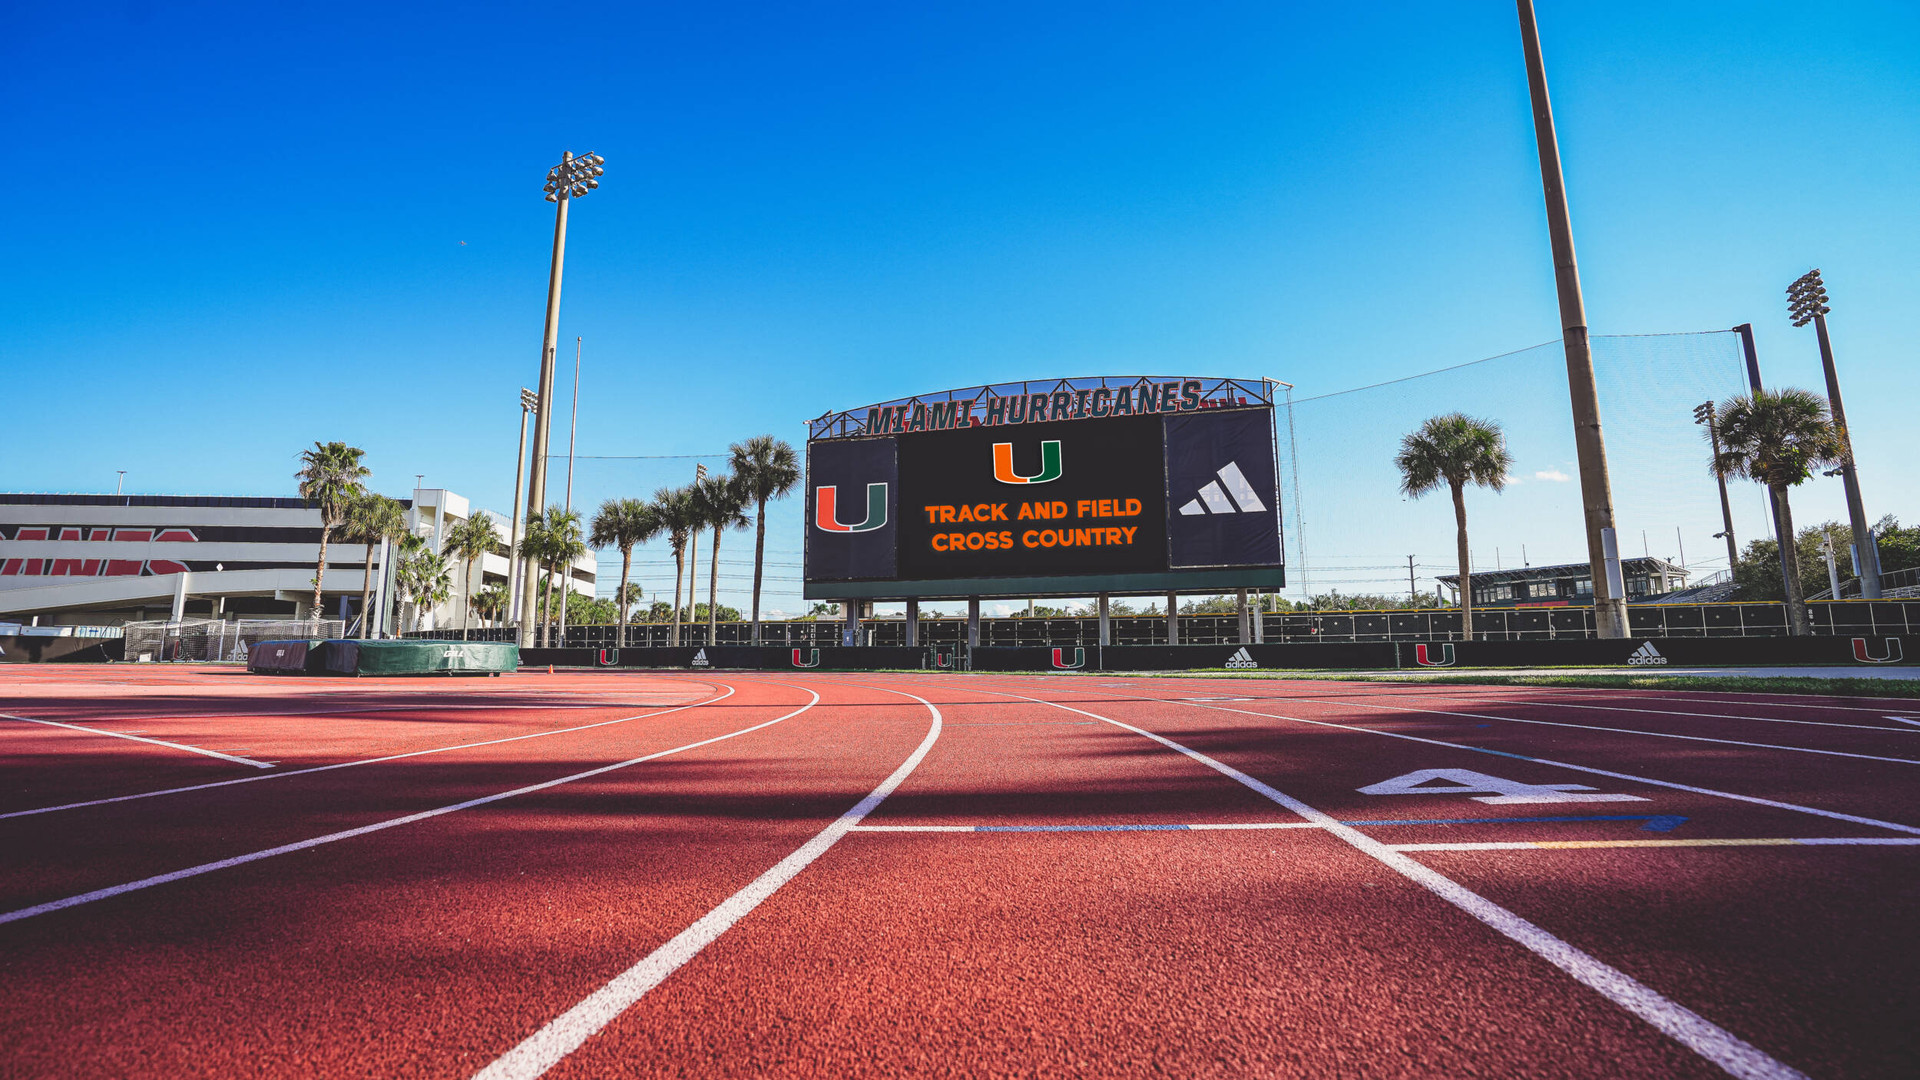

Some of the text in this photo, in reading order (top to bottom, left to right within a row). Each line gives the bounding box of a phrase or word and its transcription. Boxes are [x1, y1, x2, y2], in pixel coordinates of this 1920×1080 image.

[865, 380, 1203, 436] MIAMI HURRICANES
[992, 439, 1063, 485] U
[816, 482, 888, 533] U
[925, 498, 1142, 524] TRACK AND FIELD
[931, 526, 1138, 552] CROSS COUNTRY
[600, 648, 619, 666] U
[791, 648, 820, 668] U
[937, 653, 952, 667] U
[1052, 647, 1086, 669] U
[1415, 643, 1456, 667] U
[1627, 655, 1668, 666] adidas
[1851, 637, 1904, 663] U
[1225, 660, 1258, 669] adidas
[1355, 768, 1655, 805] 4
